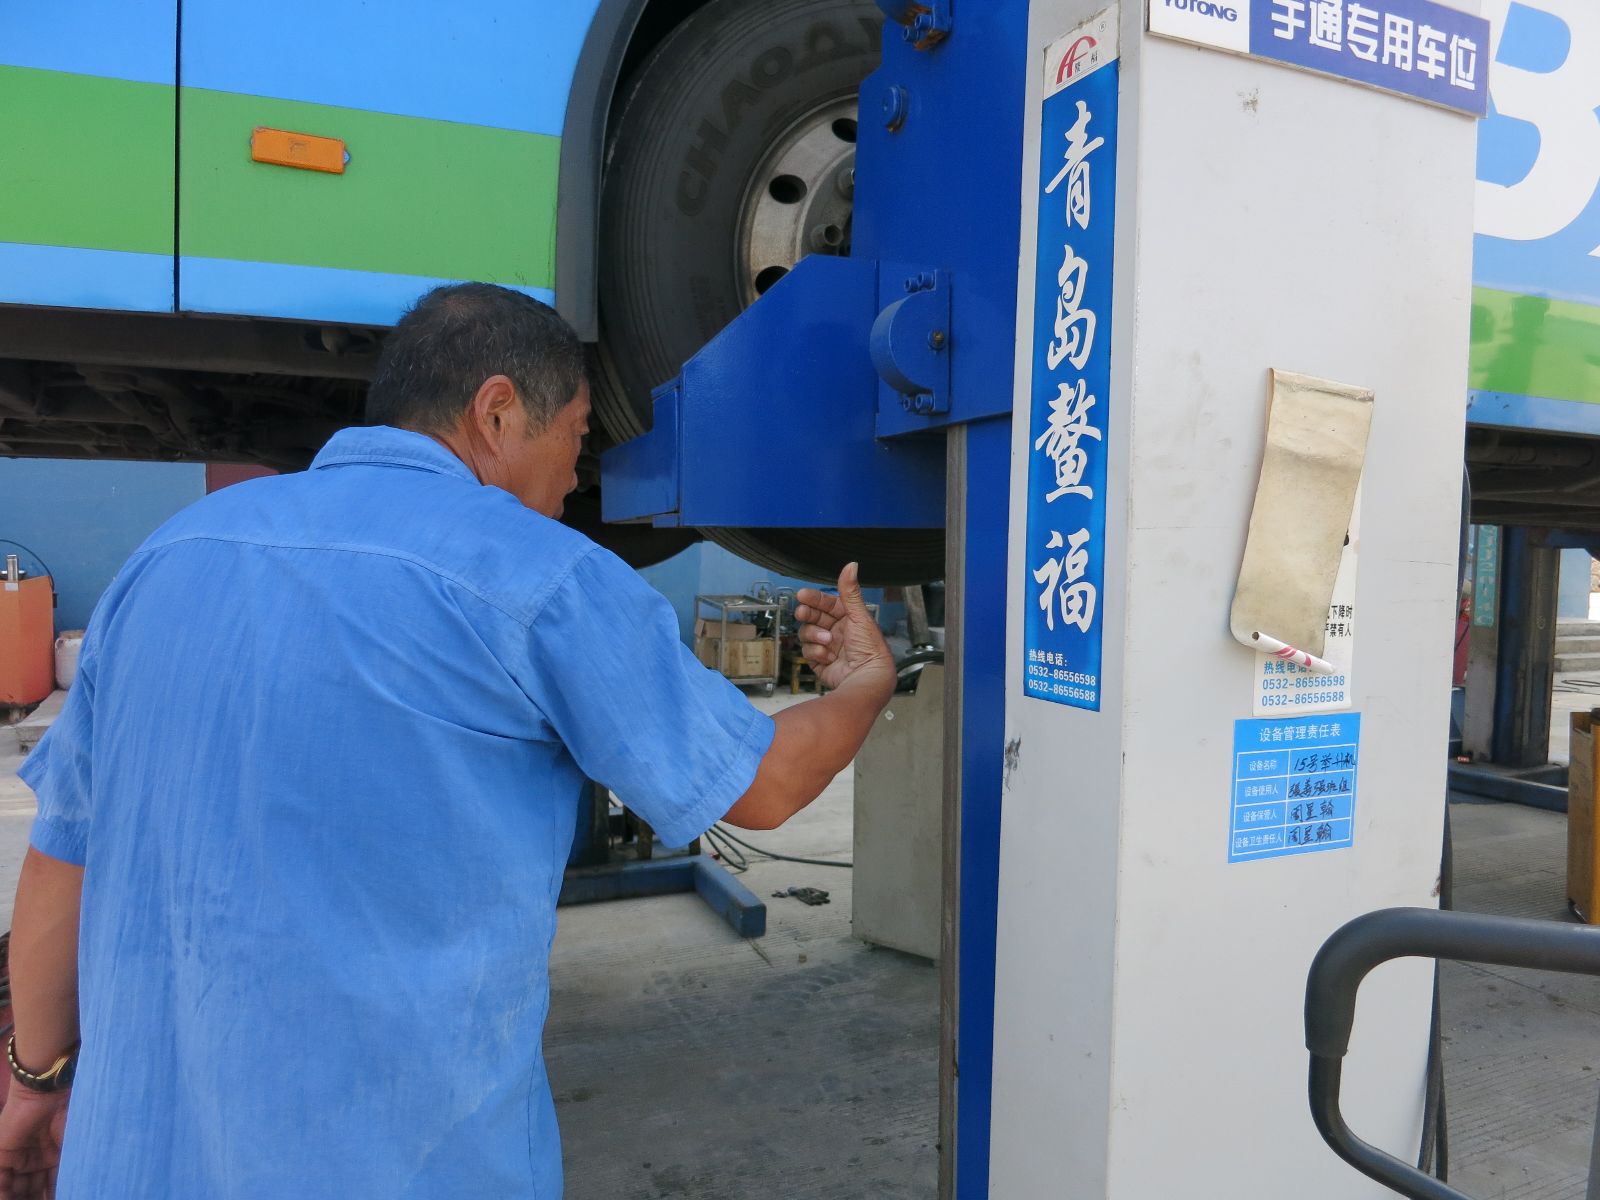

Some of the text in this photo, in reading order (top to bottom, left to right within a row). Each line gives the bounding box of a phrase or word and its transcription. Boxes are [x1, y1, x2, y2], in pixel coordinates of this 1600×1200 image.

[1028, 664, 1096, 687] 0532-86556598
[1262, 675, 1345, 690] 0532-86556598
[1028, 679, 1096, 702] 0532-86556588
[1262, 691, 1345, 706] 0532-86556588
[1260, 722, 1341, 742] 设备管理责任表
[1249, 760, 1277, 772] 设备名称
[1244, 783, 1279, 798] 设备使用人
